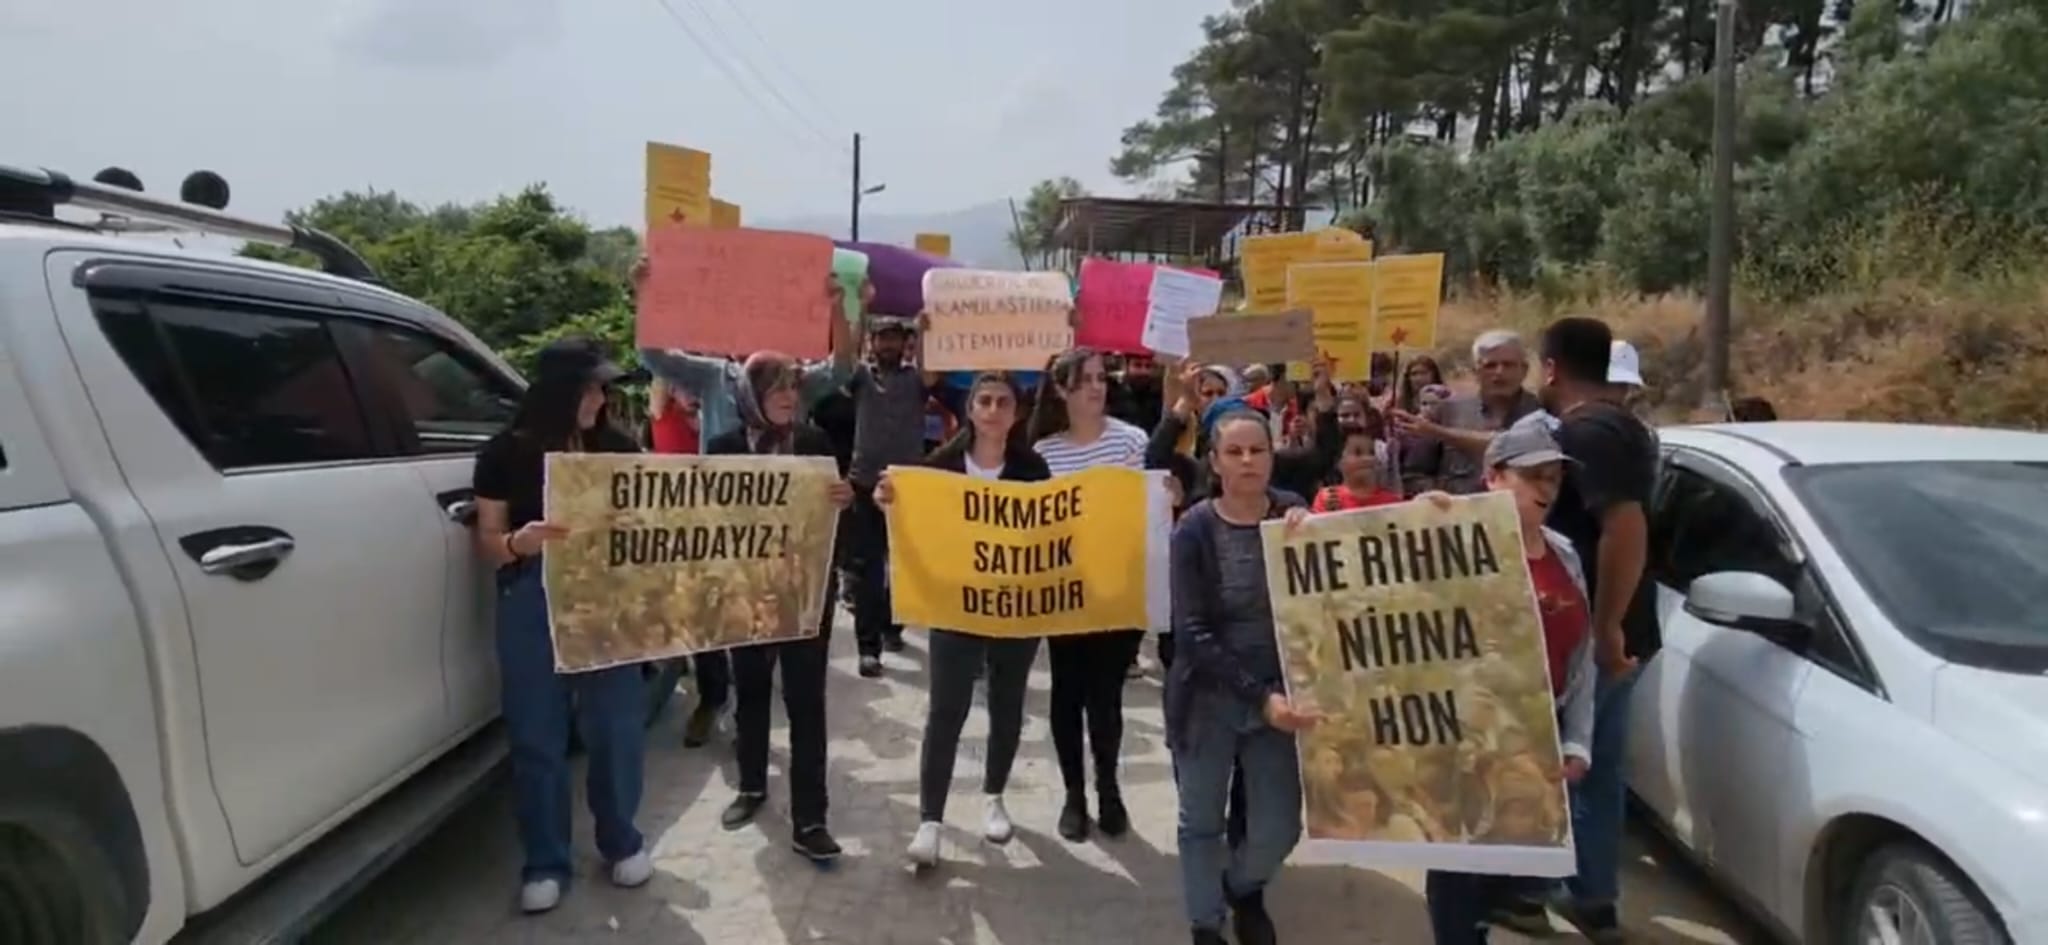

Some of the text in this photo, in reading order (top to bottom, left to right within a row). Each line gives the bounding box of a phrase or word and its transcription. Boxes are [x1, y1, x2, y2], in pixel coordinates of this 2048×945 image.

[611, 465, 790, 509] GİTMİYORUZ
[963, 486, 1082, 529] DİKMECE
[974, 536, 1073, 575] SATILIK
[1283, 522, 1499, 597] ME RİHNA
[962, 578, 1085, 619] DEĞİLDİR
[1337, 606, 1481, 671] NİHNA
[1369, 690, 1463, 746] HON
